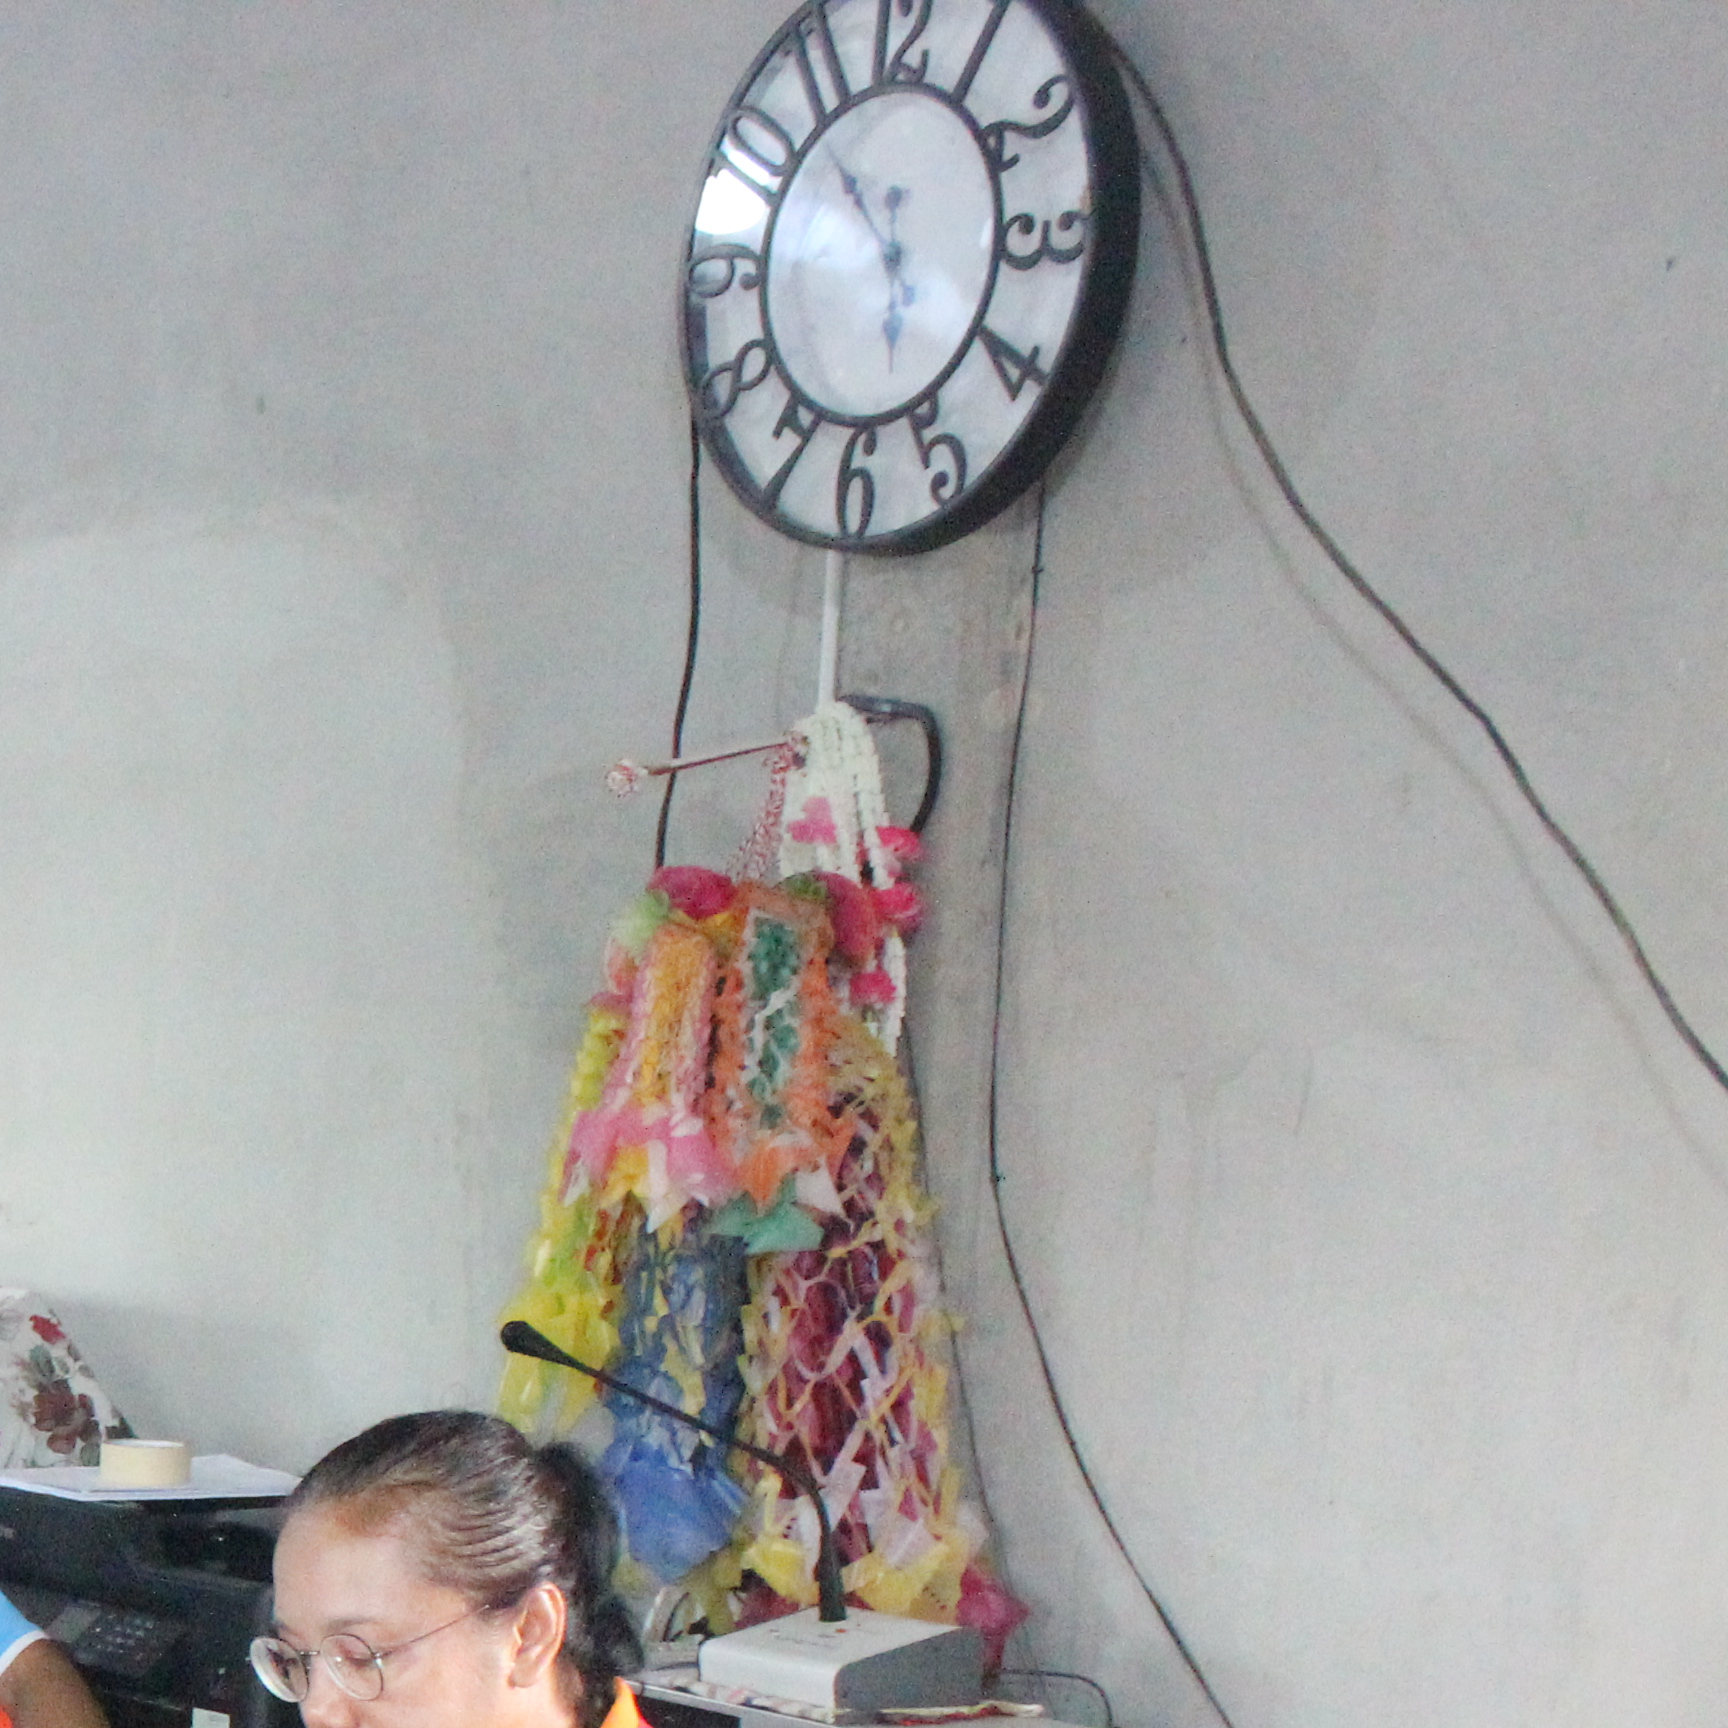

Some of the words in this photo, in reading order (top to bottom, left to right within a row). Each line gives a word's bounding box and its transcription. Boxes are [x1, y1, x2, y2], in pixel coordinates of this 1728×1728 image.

[980, 74, 1077, 172] 2
[687, 243, 763, 299] 9
[1000, 210, 1098, 271] 3
[700, 337, 774, 419] 8
[976, 323, 1050, 402] 4
[756, 397, 822, 512] 7
[836, 425, 878, 540] 6
[908, 393, 969, 505] 5
